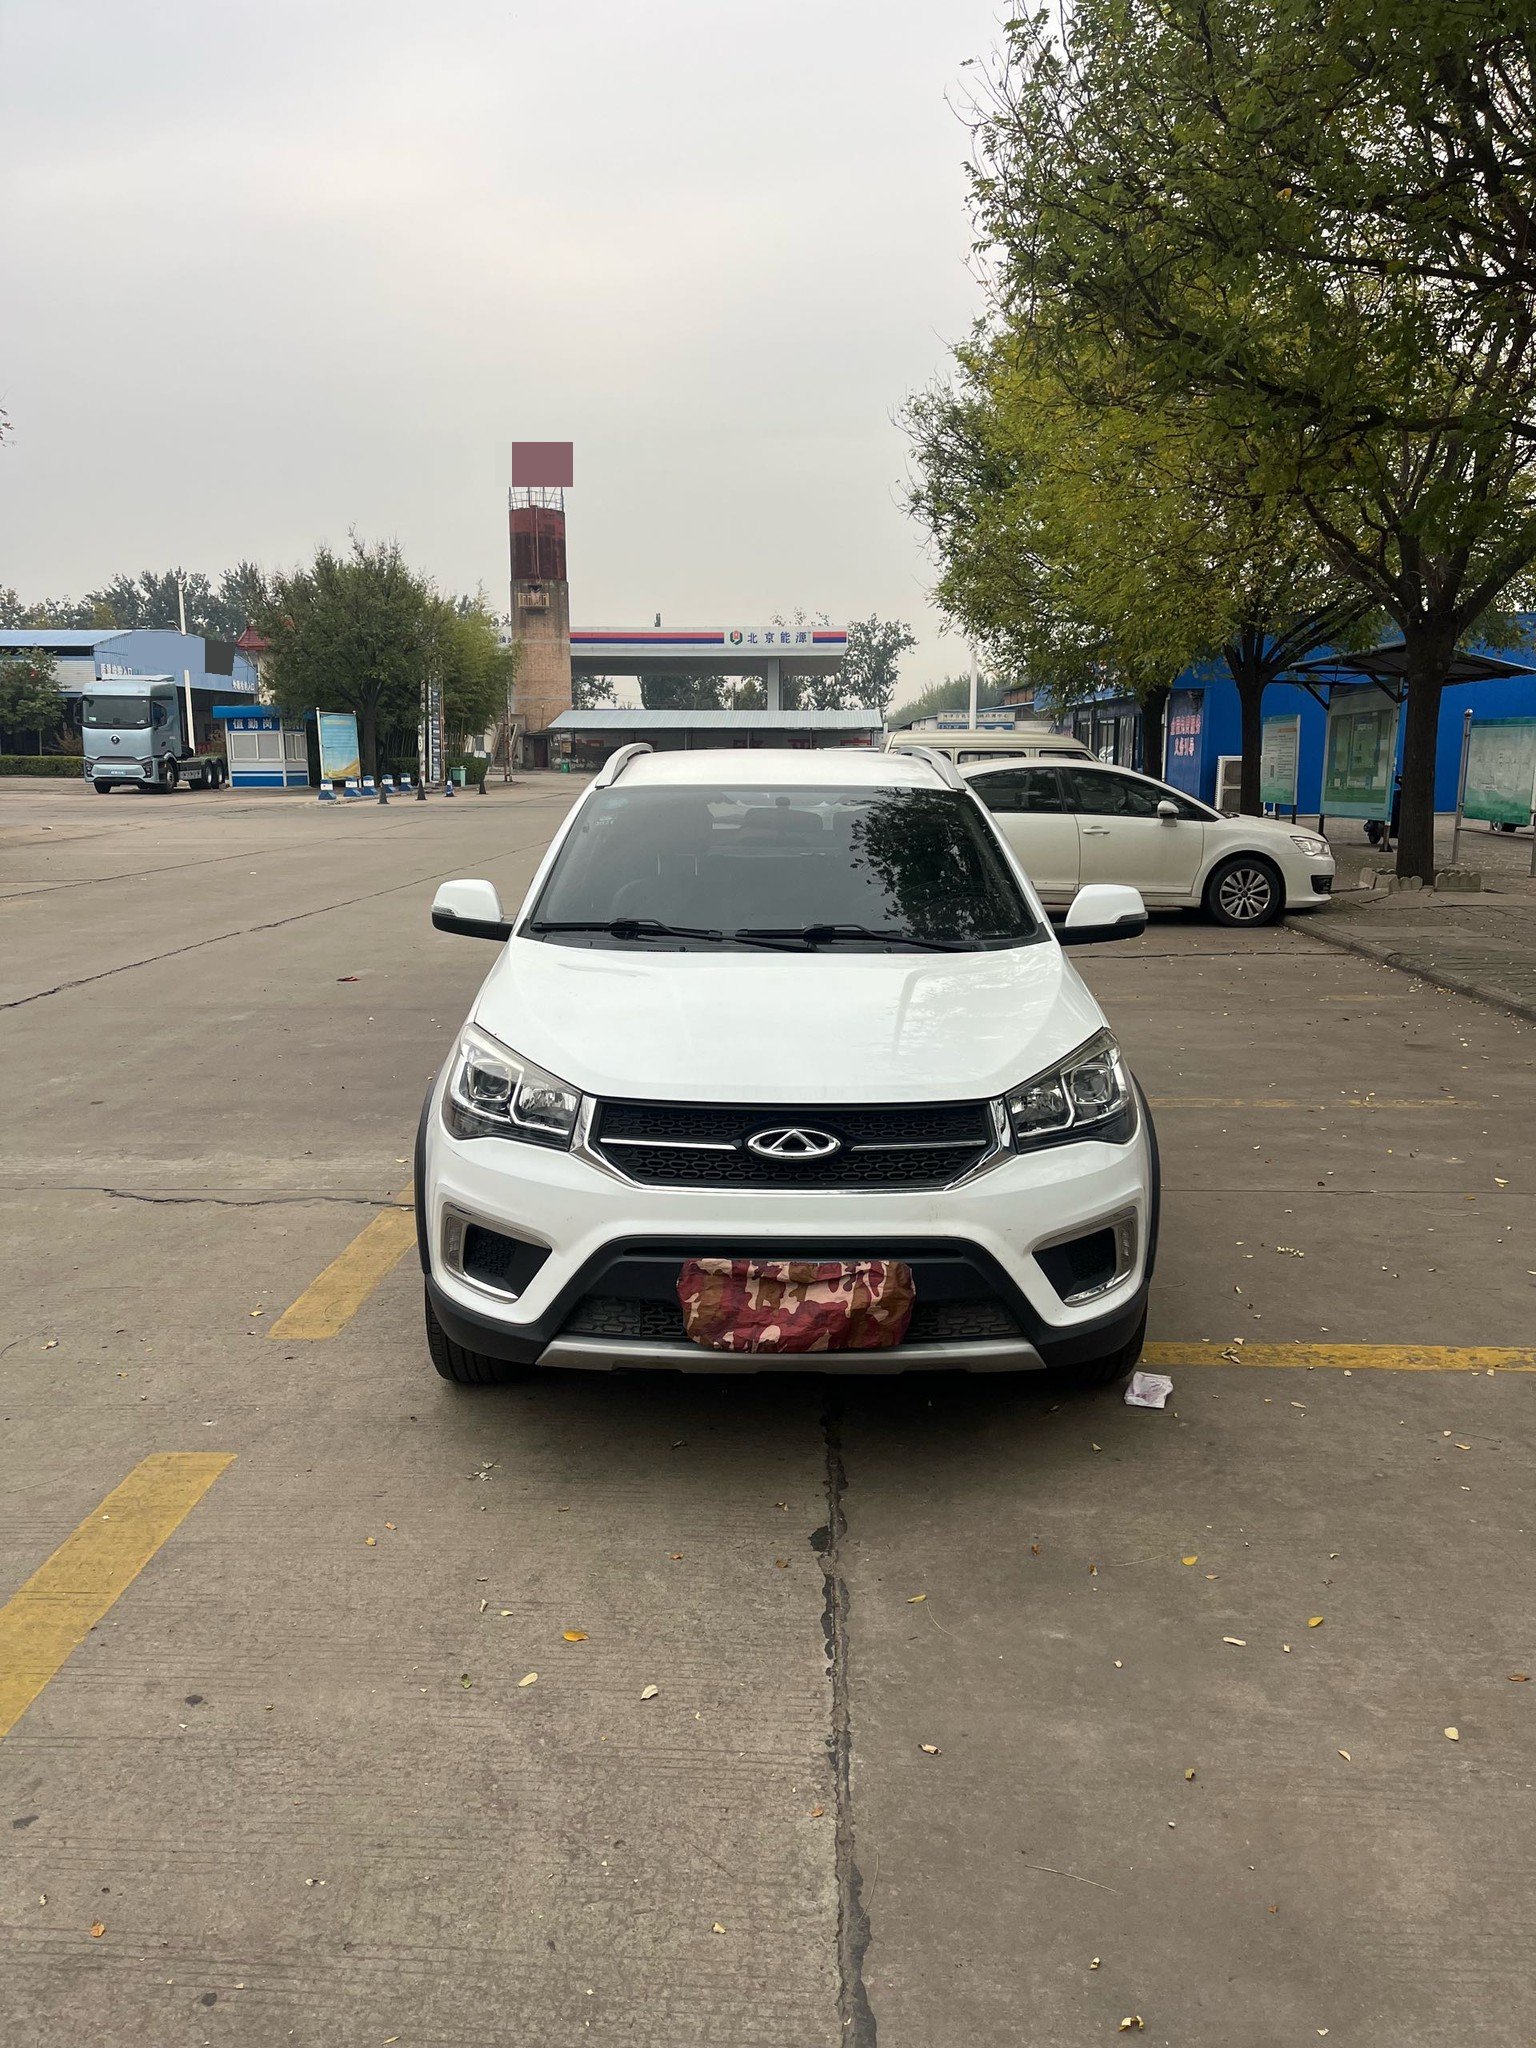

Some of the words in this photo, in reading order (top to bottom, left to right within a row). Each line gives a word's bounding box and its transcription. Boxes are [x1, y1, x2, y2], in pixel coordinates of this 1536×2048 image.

[747, 631, 807, 644] 北京能源
[232, 718, 273, 730] 值勤岗
